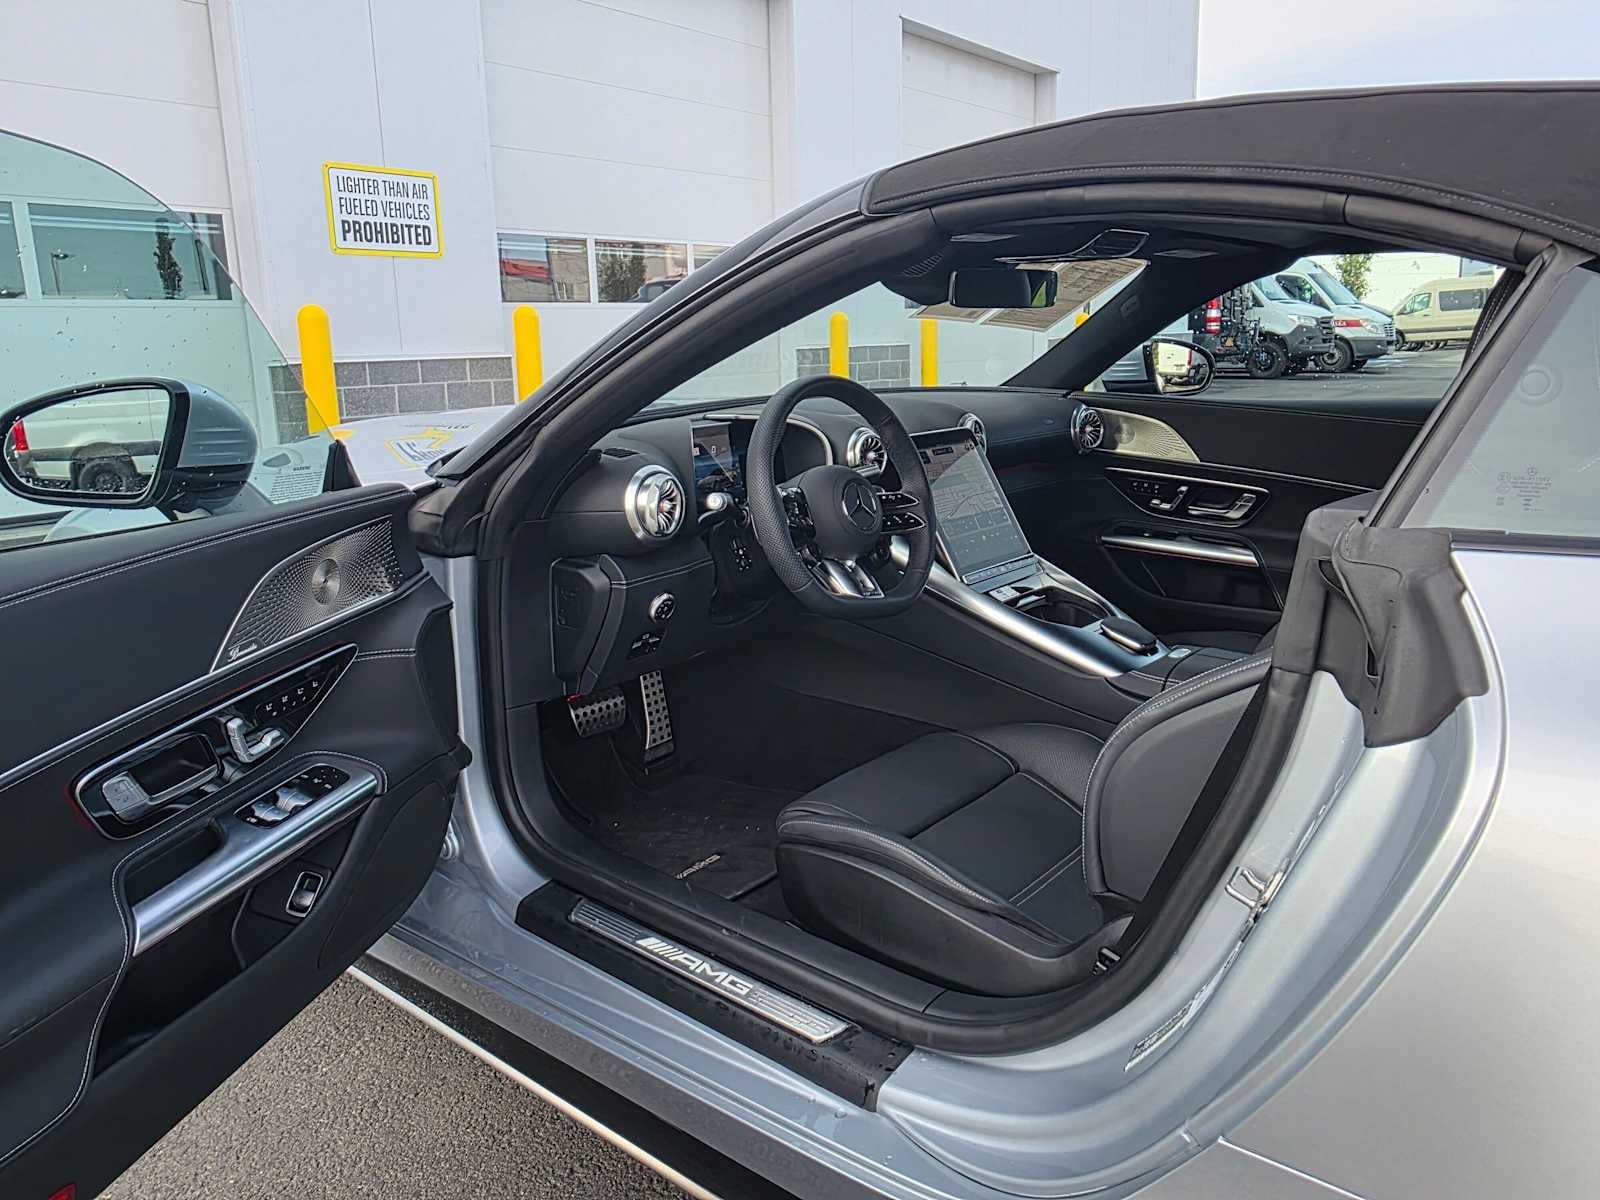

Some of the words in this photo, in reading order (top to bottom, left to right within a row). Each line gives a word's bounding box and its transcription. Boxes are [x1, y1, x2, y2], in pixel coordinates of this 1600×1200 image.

[336, 175, 380, 196] LIGHTER
[382, 180, 409, 199] THAN
[412, 183, 428, 200] AIR
[339, 196, 378, 217] FUELED
[381, 200, 430, 221] VEHICLES
[341, 219, 432, 246] PROHIBITED
[668, 952, 754, 996] AMG
